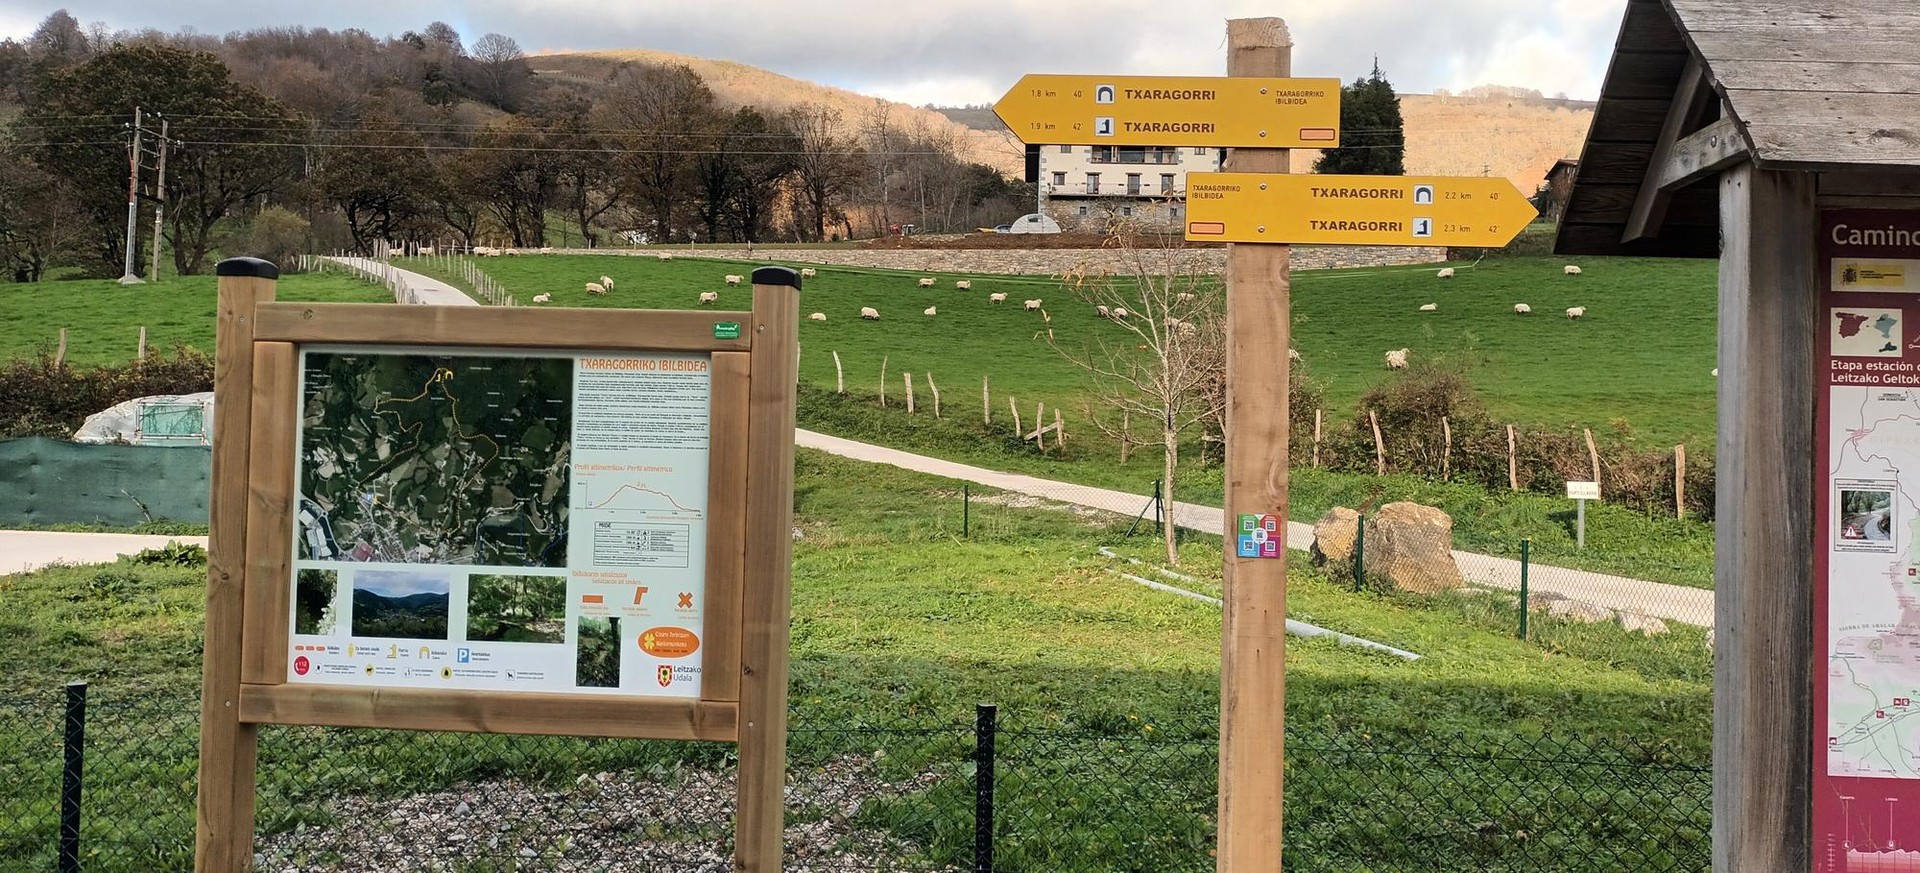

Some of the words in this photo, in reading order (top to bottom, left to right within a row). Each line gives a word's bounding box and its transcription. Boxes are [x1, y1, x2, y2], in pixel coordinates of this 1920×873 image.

[1125, 89, 1216, 101] TXARAGORRI
[1275, 90, 1325, 98] TXARAGORRIKO
[1044, 122, 1056, 130] km
[1124, 122, 1215, 133] TXARAGORRI
[1192, 184, 1241, 192] TXARAGORRIKO
[1191, 192, 1224, 200] IBILBIDEA
[1311, 187, 1403, 199] TXARAGORRI
[1460, 192, 1472, 200] km
[1310, 220, 1402, 232] TXARAGORRI
[1459, 224, 1471, 232] km
[580, 358, 656, 370] TXARAGORRIKO
[659, 360, 707, 372] IBILBIDEA
[1831, 360, 1863, 372] Etapa
[1866, 361, 1914, 372] estación
[1831, 373, 1880, 383] Leitzako
[673, 665, 702, 673] Leitzako
[673, 674, 693, 682] Udala
